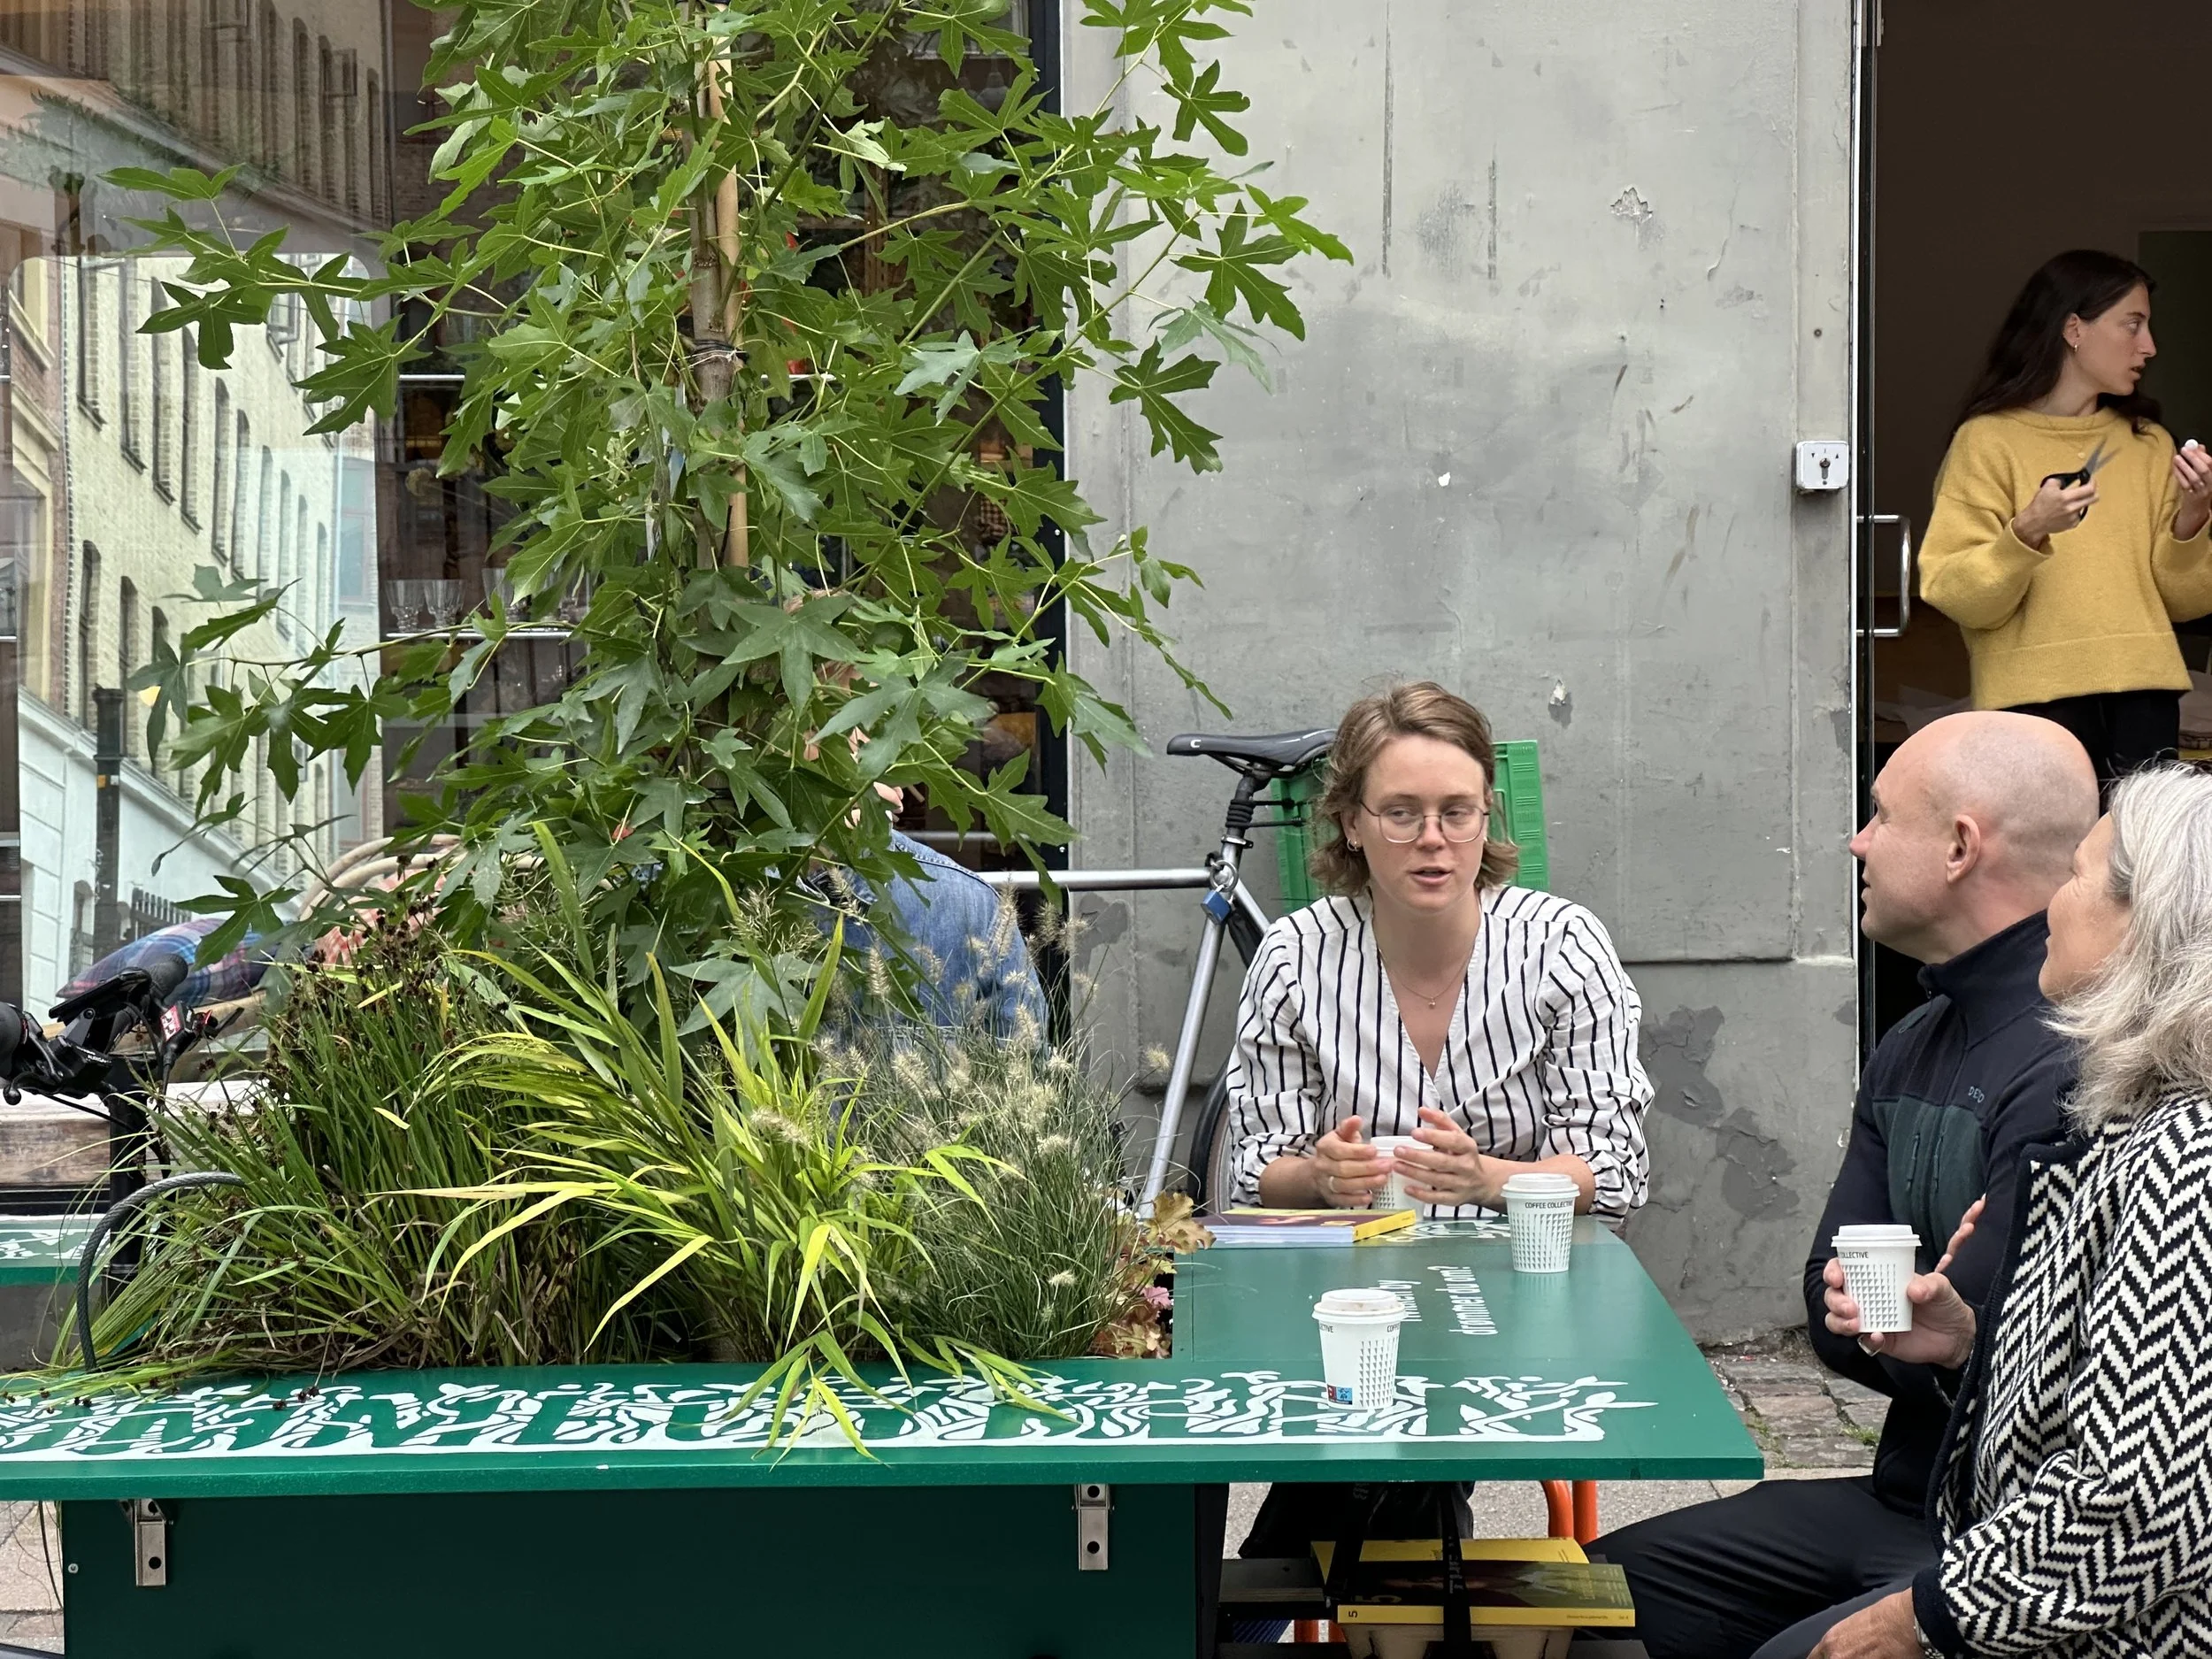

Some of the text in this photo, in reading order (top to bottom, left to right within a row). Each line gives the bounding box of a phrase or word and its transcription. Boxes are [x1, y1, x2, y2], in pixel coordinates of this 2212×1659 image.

[1369, 1279, 1422, 1290] by
[1427, 1266, 1499, 1335] drømmer du om?
